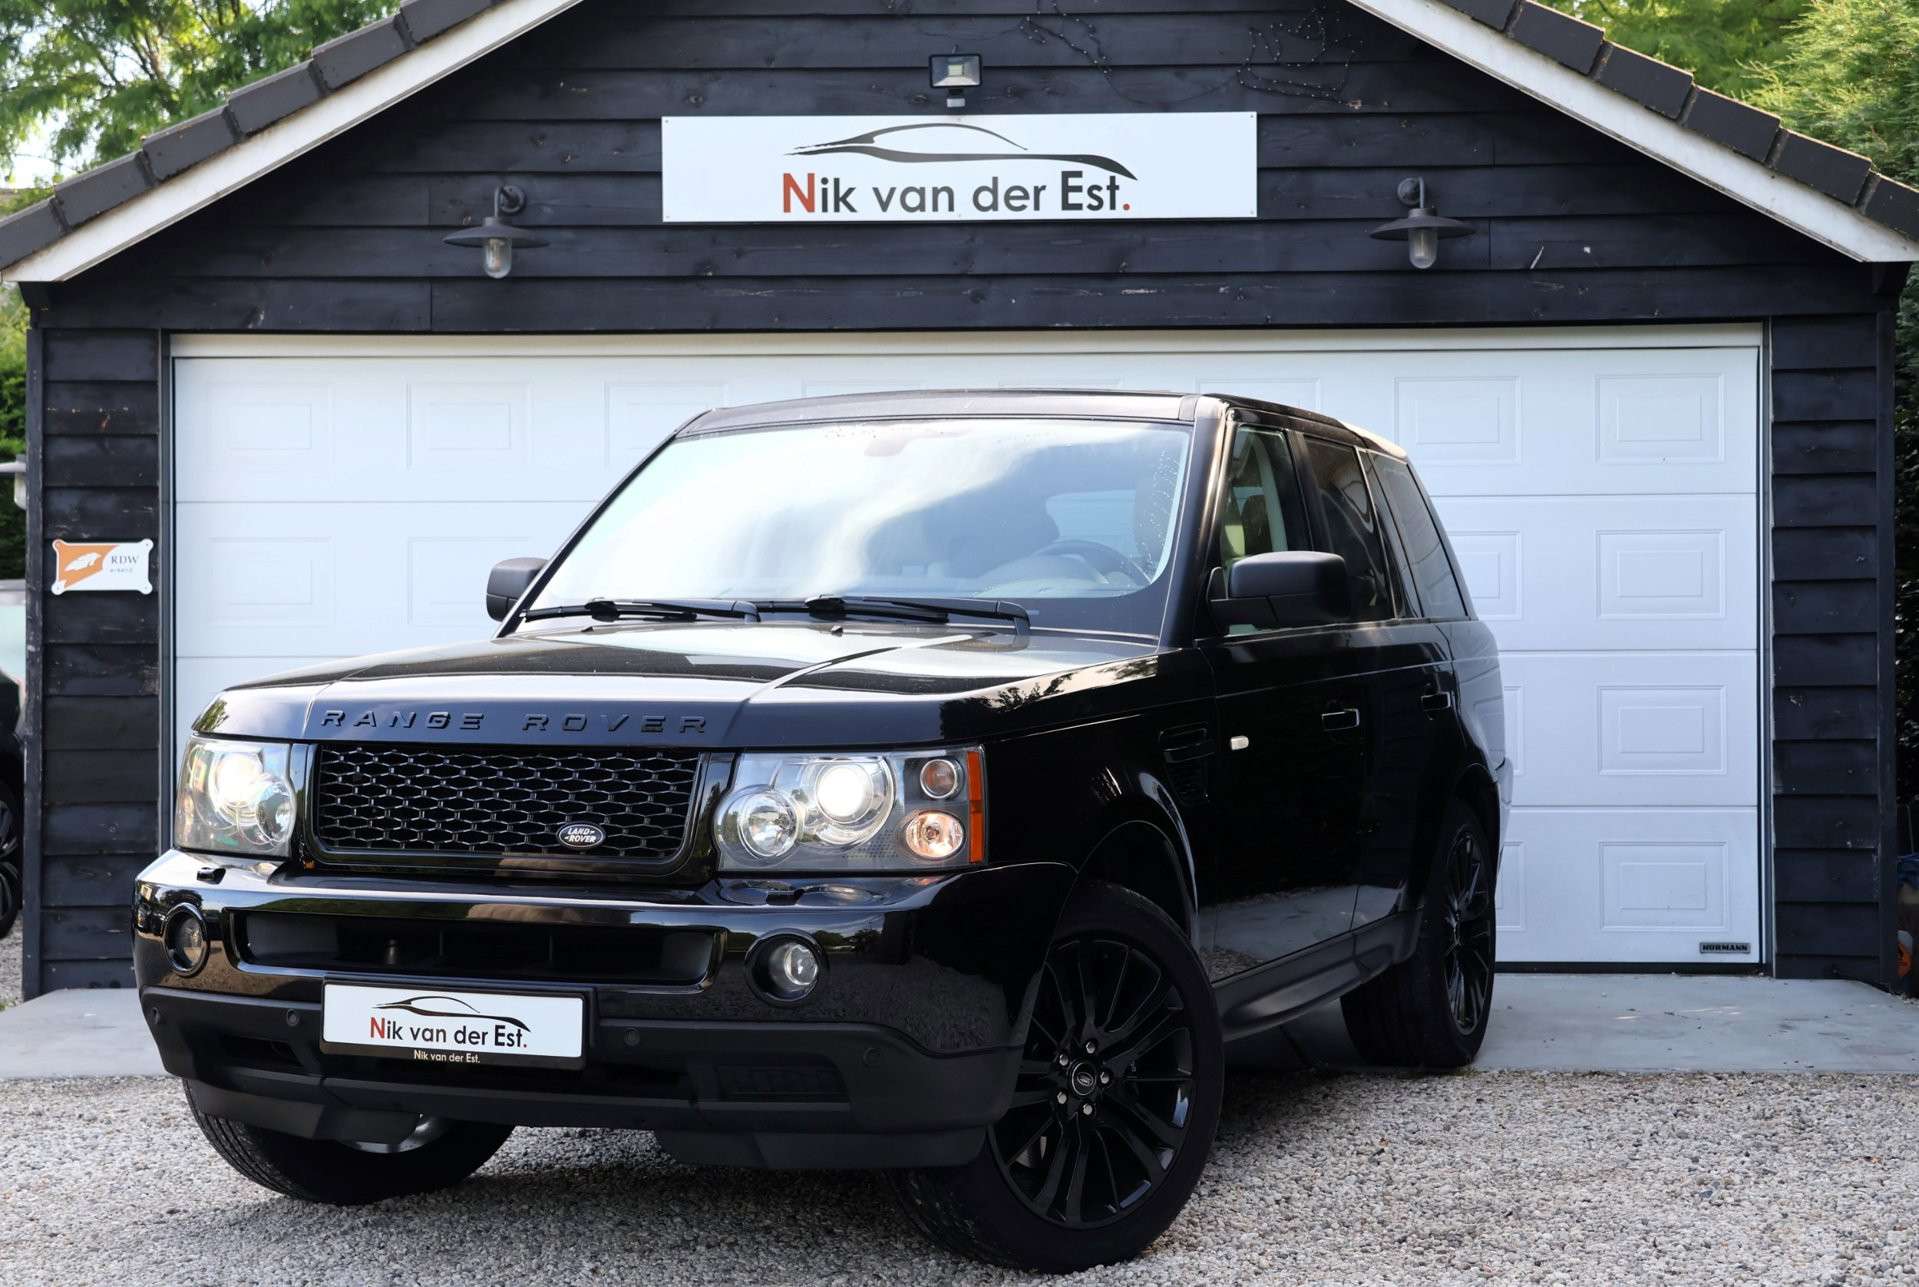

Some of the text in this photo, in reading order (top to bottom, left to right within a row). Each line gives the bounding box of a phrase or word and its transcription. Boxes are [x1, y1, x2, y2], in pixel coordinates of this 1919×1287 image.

[783, 170, 1131, 213] Nik van der Est.
[111, 555, 138, 564] RDW
[320, 709, 708, 734] RANGE ROVER
[567, 827, 591, 835] LAND
[569, 834, 597, 843] ROVER
[370, 1016, 527, 1048] Nik van der Est.
[413, 1050, 481, 1064] Nik van der Est.
